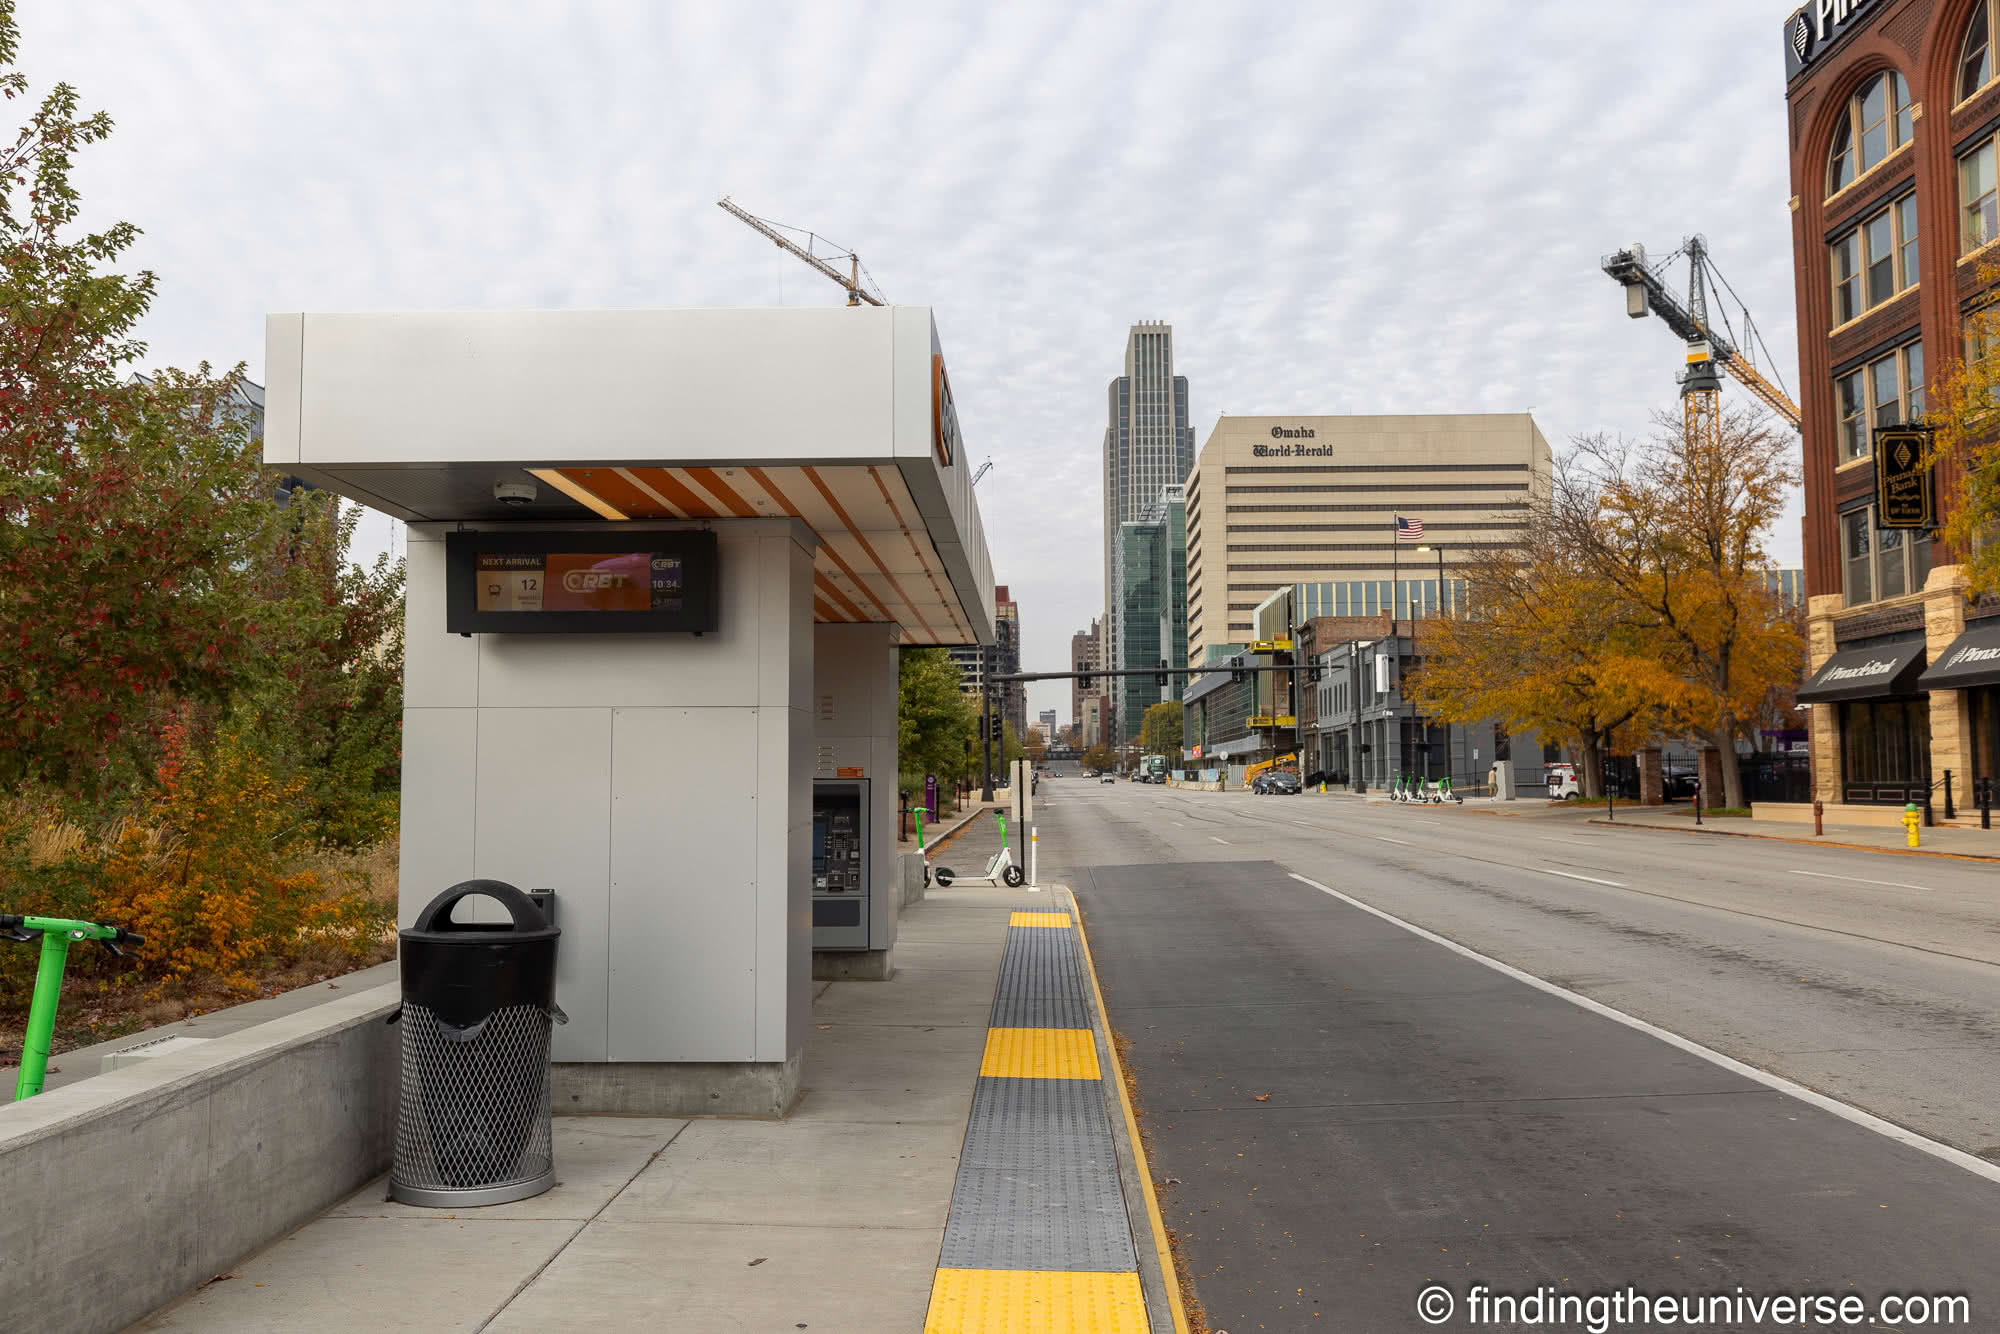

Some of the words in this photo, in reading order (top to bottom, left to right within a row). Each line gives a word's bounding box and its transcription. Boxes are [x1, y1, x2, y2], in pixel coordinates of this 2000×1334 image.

[1271, 426, 1315, 439] Omaha
[1252, 444, 1333, 457] World-Herald
[482, 558, 504, 566] NEXT
[505, 558, 542, 566] ARRIVAL
[521, 579, 537, 591] 12
[1866, 658, 1897, 676] Bank
